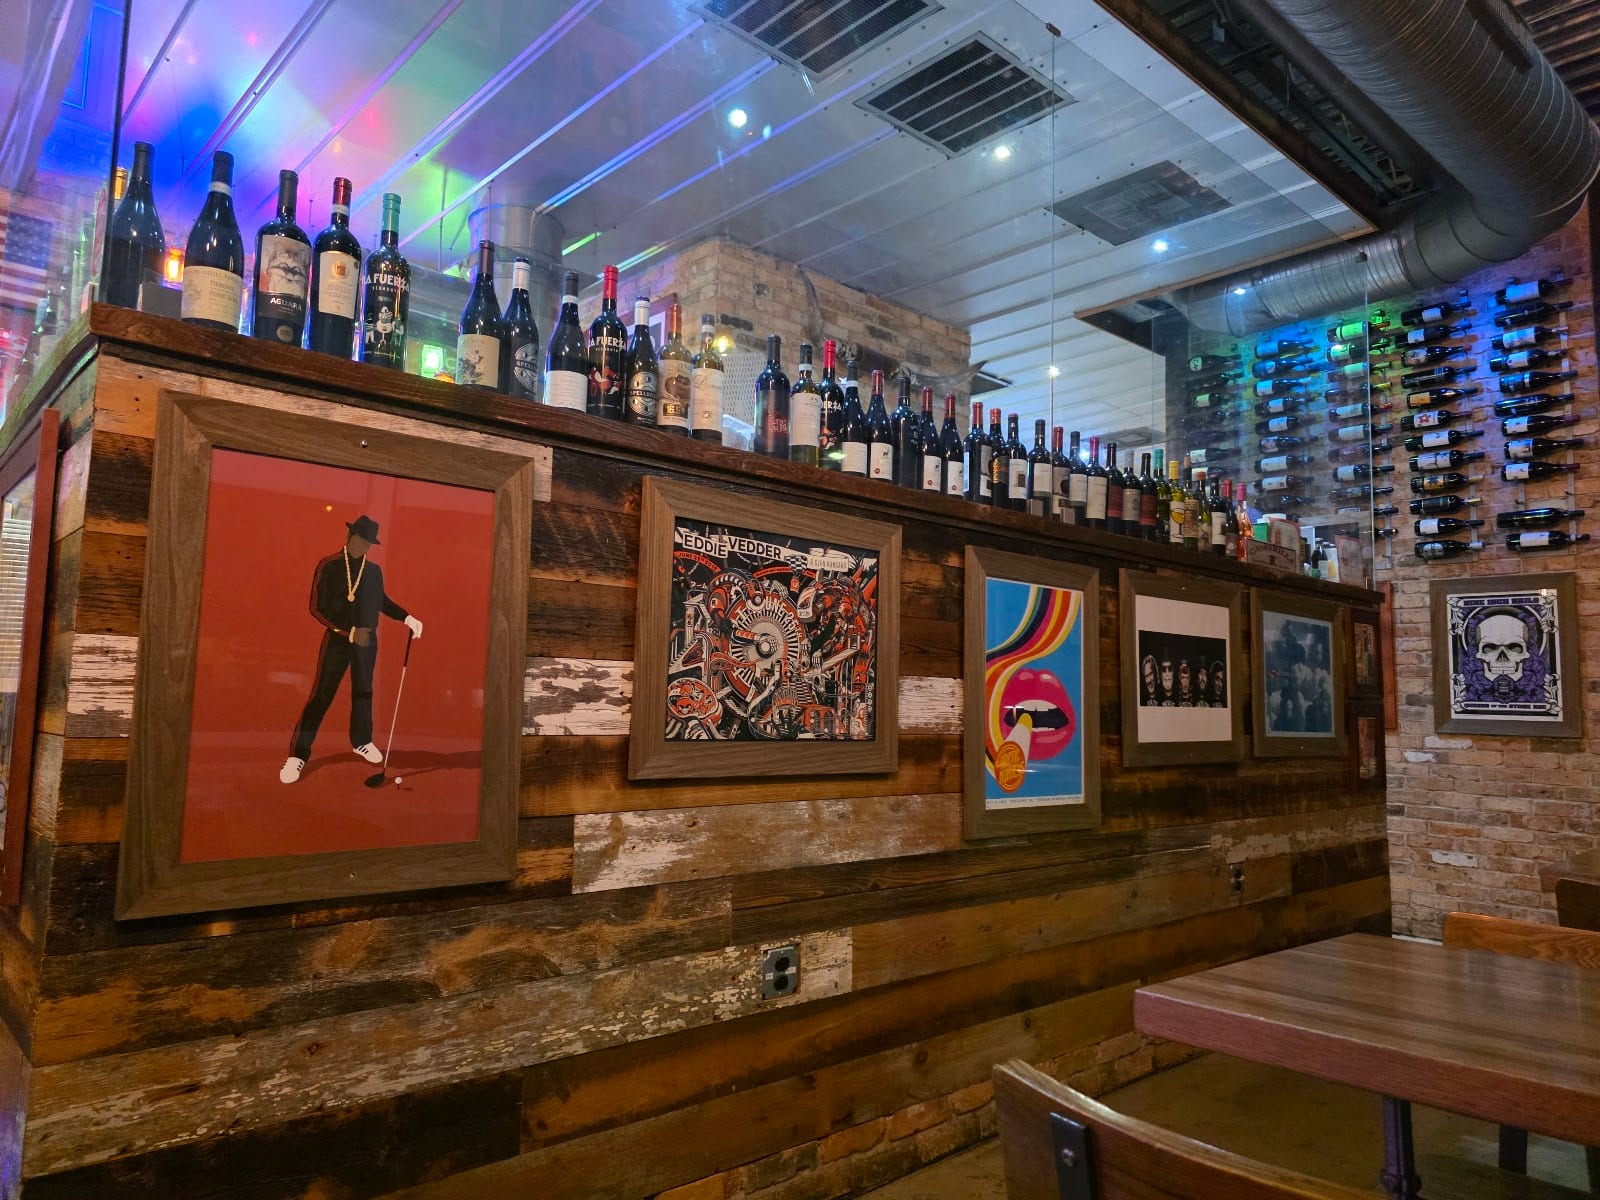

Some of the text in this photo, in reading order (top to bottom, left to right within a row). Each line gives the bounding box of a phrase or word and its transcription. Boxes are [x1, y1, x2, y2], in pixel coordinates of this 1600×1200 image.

[596, 336, 627, 351] FUERZA
[684, 534, 782, 560] EDDIE VEDDER
